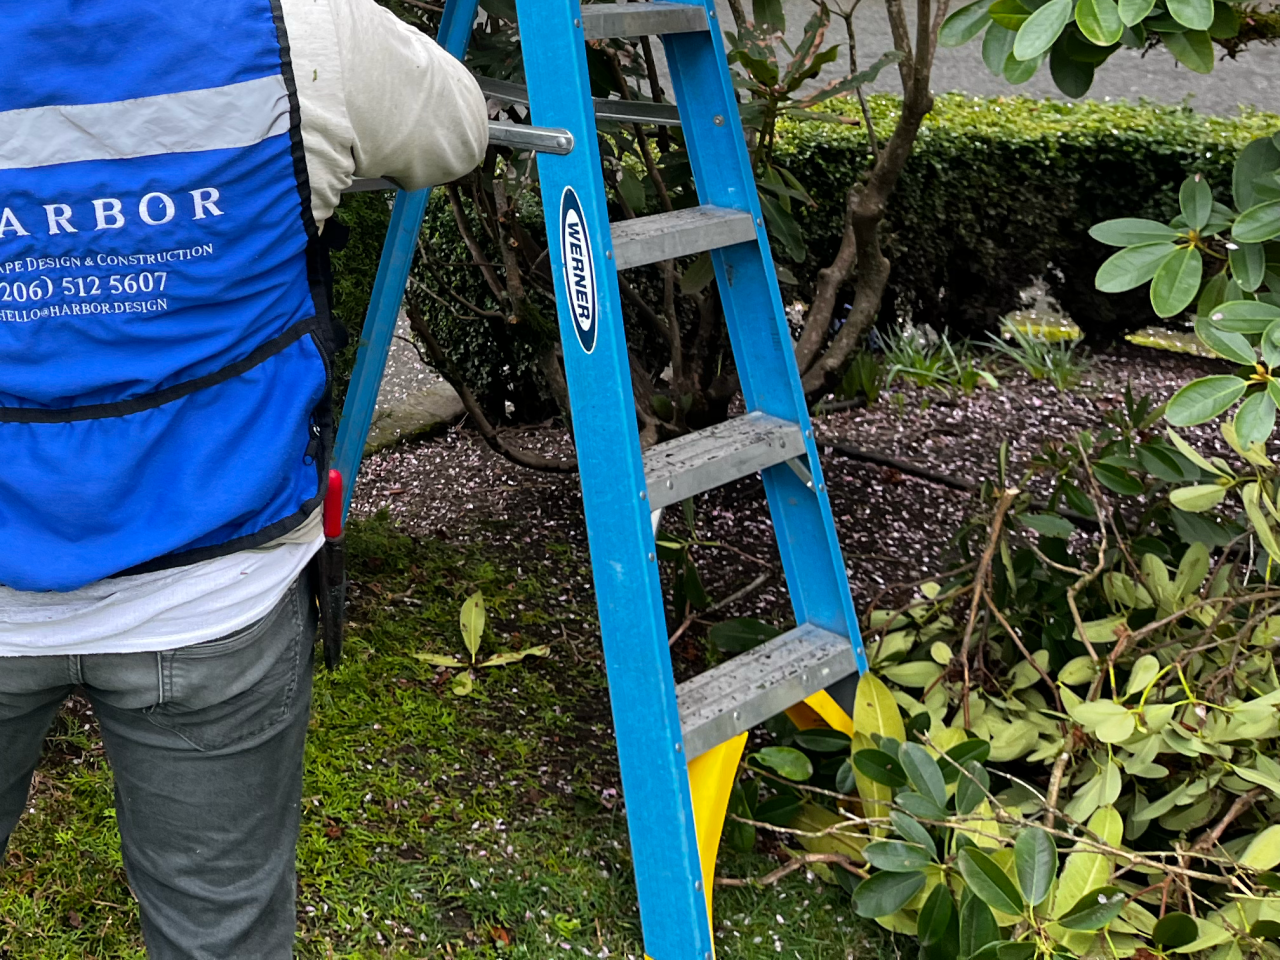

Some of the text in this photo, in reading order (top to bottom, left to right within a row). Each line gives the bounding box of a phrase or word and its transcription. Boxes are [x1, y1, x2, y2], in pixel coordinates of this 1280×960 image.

[84, 256, 95, 268] &
[567, 221, 591, 323] WERNER
[61, 276, 102, 297] 512
[110, 271, 168, 295] 5607
